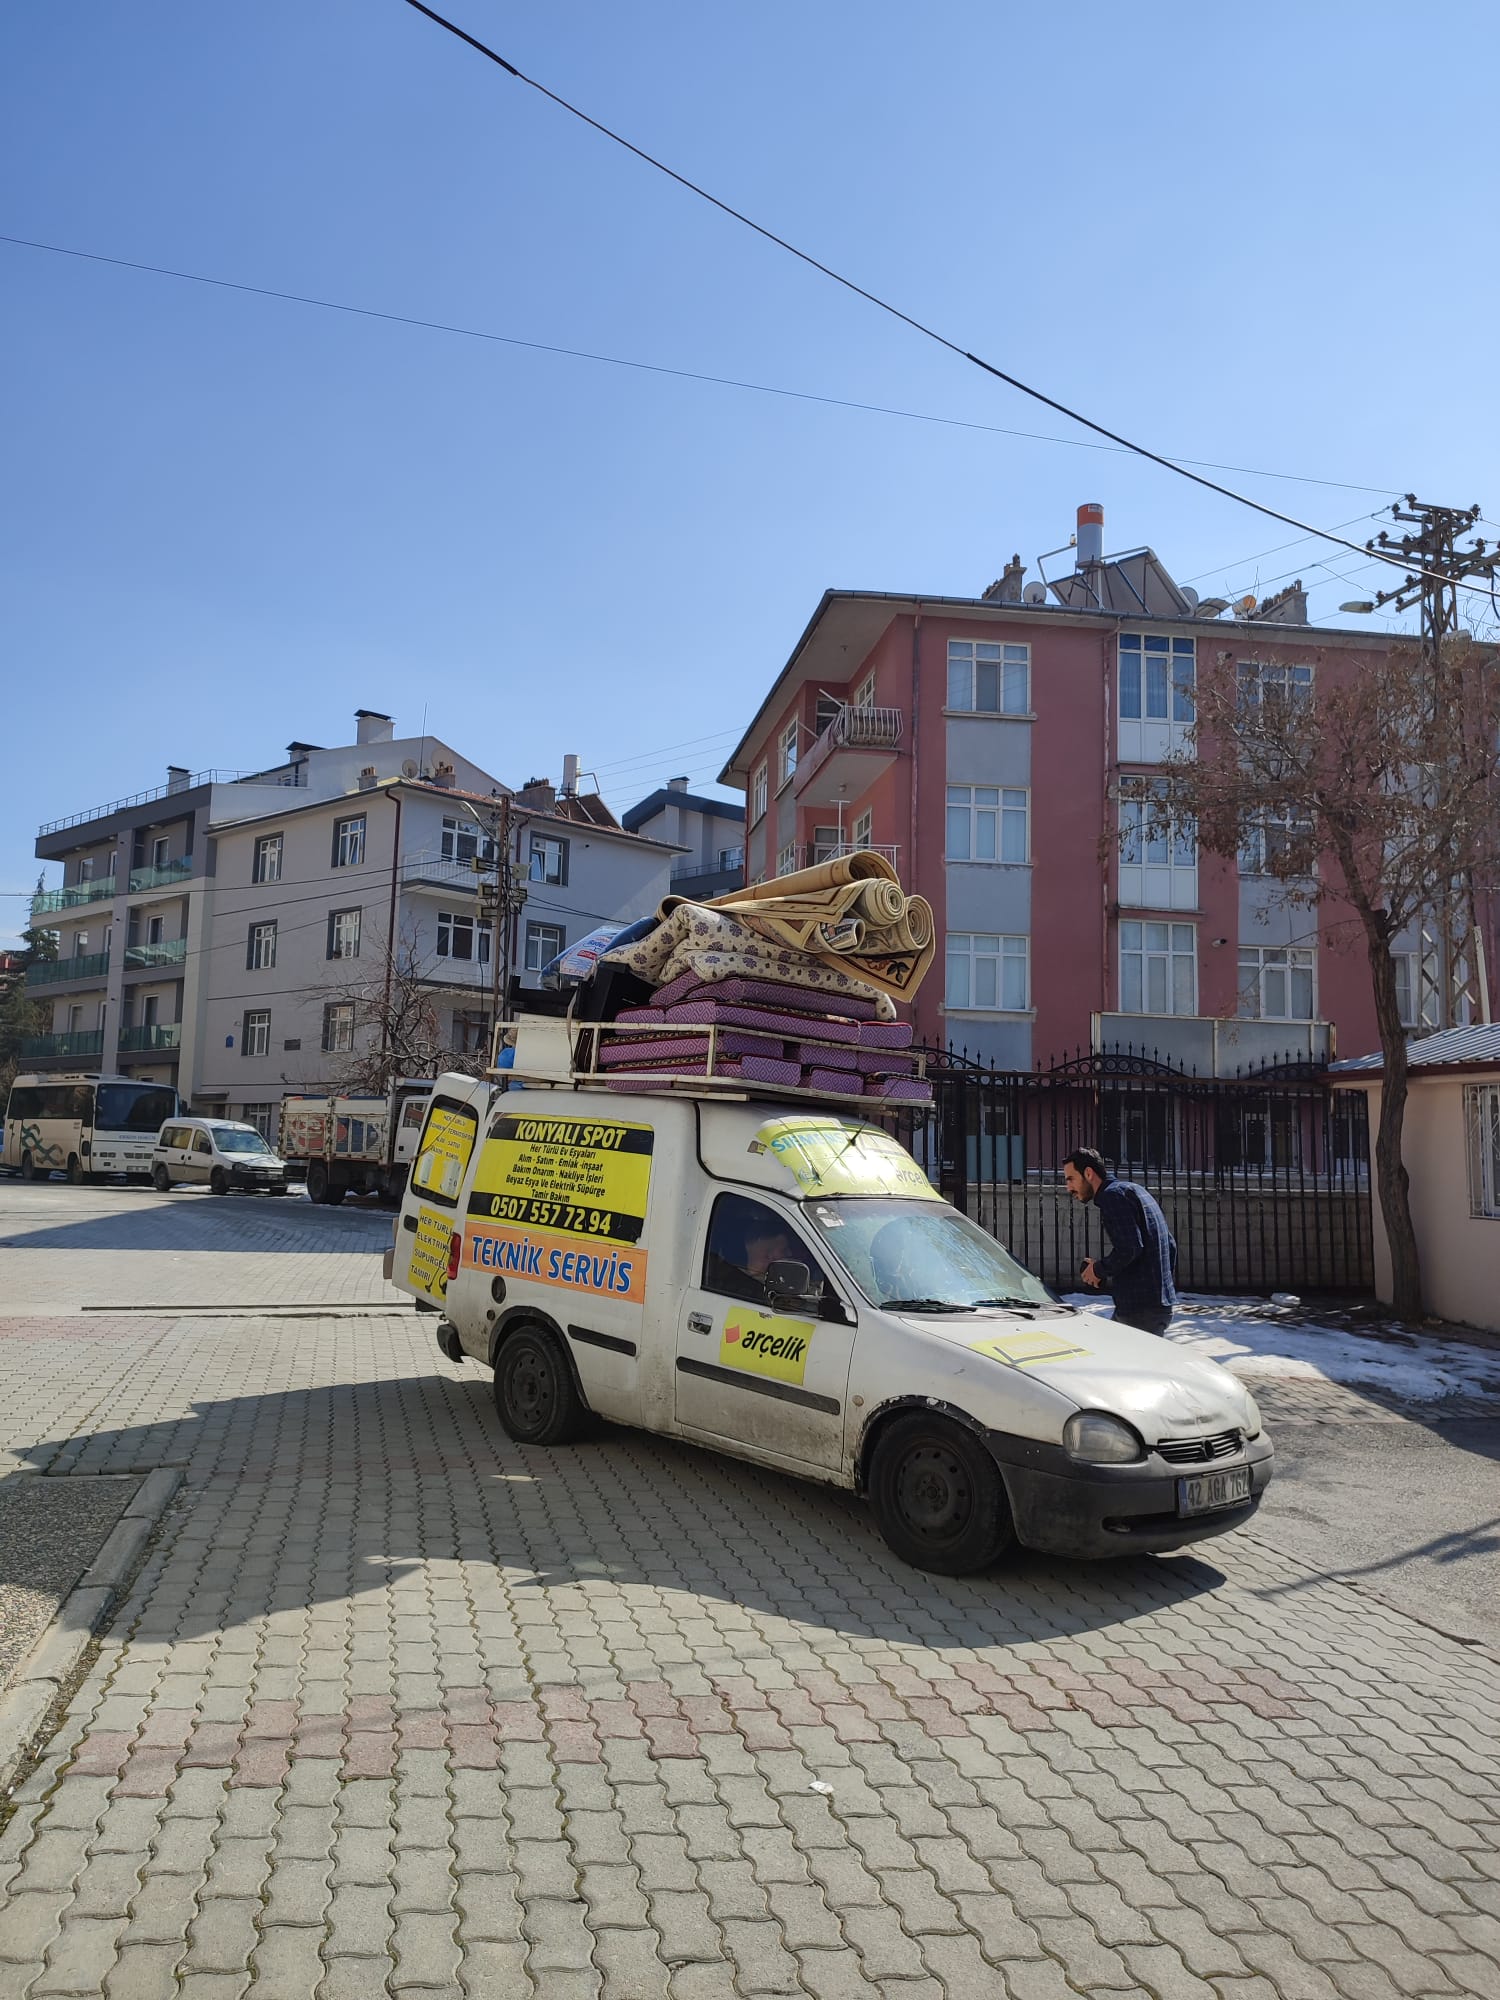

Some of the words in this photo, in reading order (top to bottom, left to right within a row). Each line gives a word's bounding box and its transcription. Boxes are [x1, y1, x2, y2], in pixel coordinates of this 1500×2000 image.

[515, 1121, 578, 1145] KONYALI
[580, 1124, 627, 1150] SPOT
[518, 1154, 532, 1164] Alım
[536, 1156, 554, 1166] Satım
[558, 1159, 578, 1169] Emlak
[530, 1143, 542, 1154] Her
[543, 1146, 558, 1156] Türlü
[560, 1148, 568, 1156] Ev
[570, 1148, 596, 1159] Eşyaları
[512, 1164, 532, 1174] Bakım
[532, 1167, 554, 1178] Onarım
[559, 1170, 584, 1182] Nakliye
[506, 1174, 524, 1186] Beyaz
[525, 1177, 540, 1188] Eşya
[540, 1179, 549, 1189] Ve
[550, 1180, 575, 1192] Elektrik
[576, 1184, 606, 1197] Süpürge
[532, 1188, 549, 1200] Tamir
[550, 1192, 570, 1203] Bakım
[420, 1215, 432, 1226] HER
[490, 1195, 527, 1220] 0507
[529, 1202, 560, 1226] 557
[564, 1207, 586, 1230] 72
[588, 1210, 612, 1235] 94
[472, 1235, 544, 1276] TEKNİK
[548, 1248, 633, 1294] SERVİS
[742, 1330, 806, 1362] arçelik
[1188, 1482, 1202, 1507] 42
